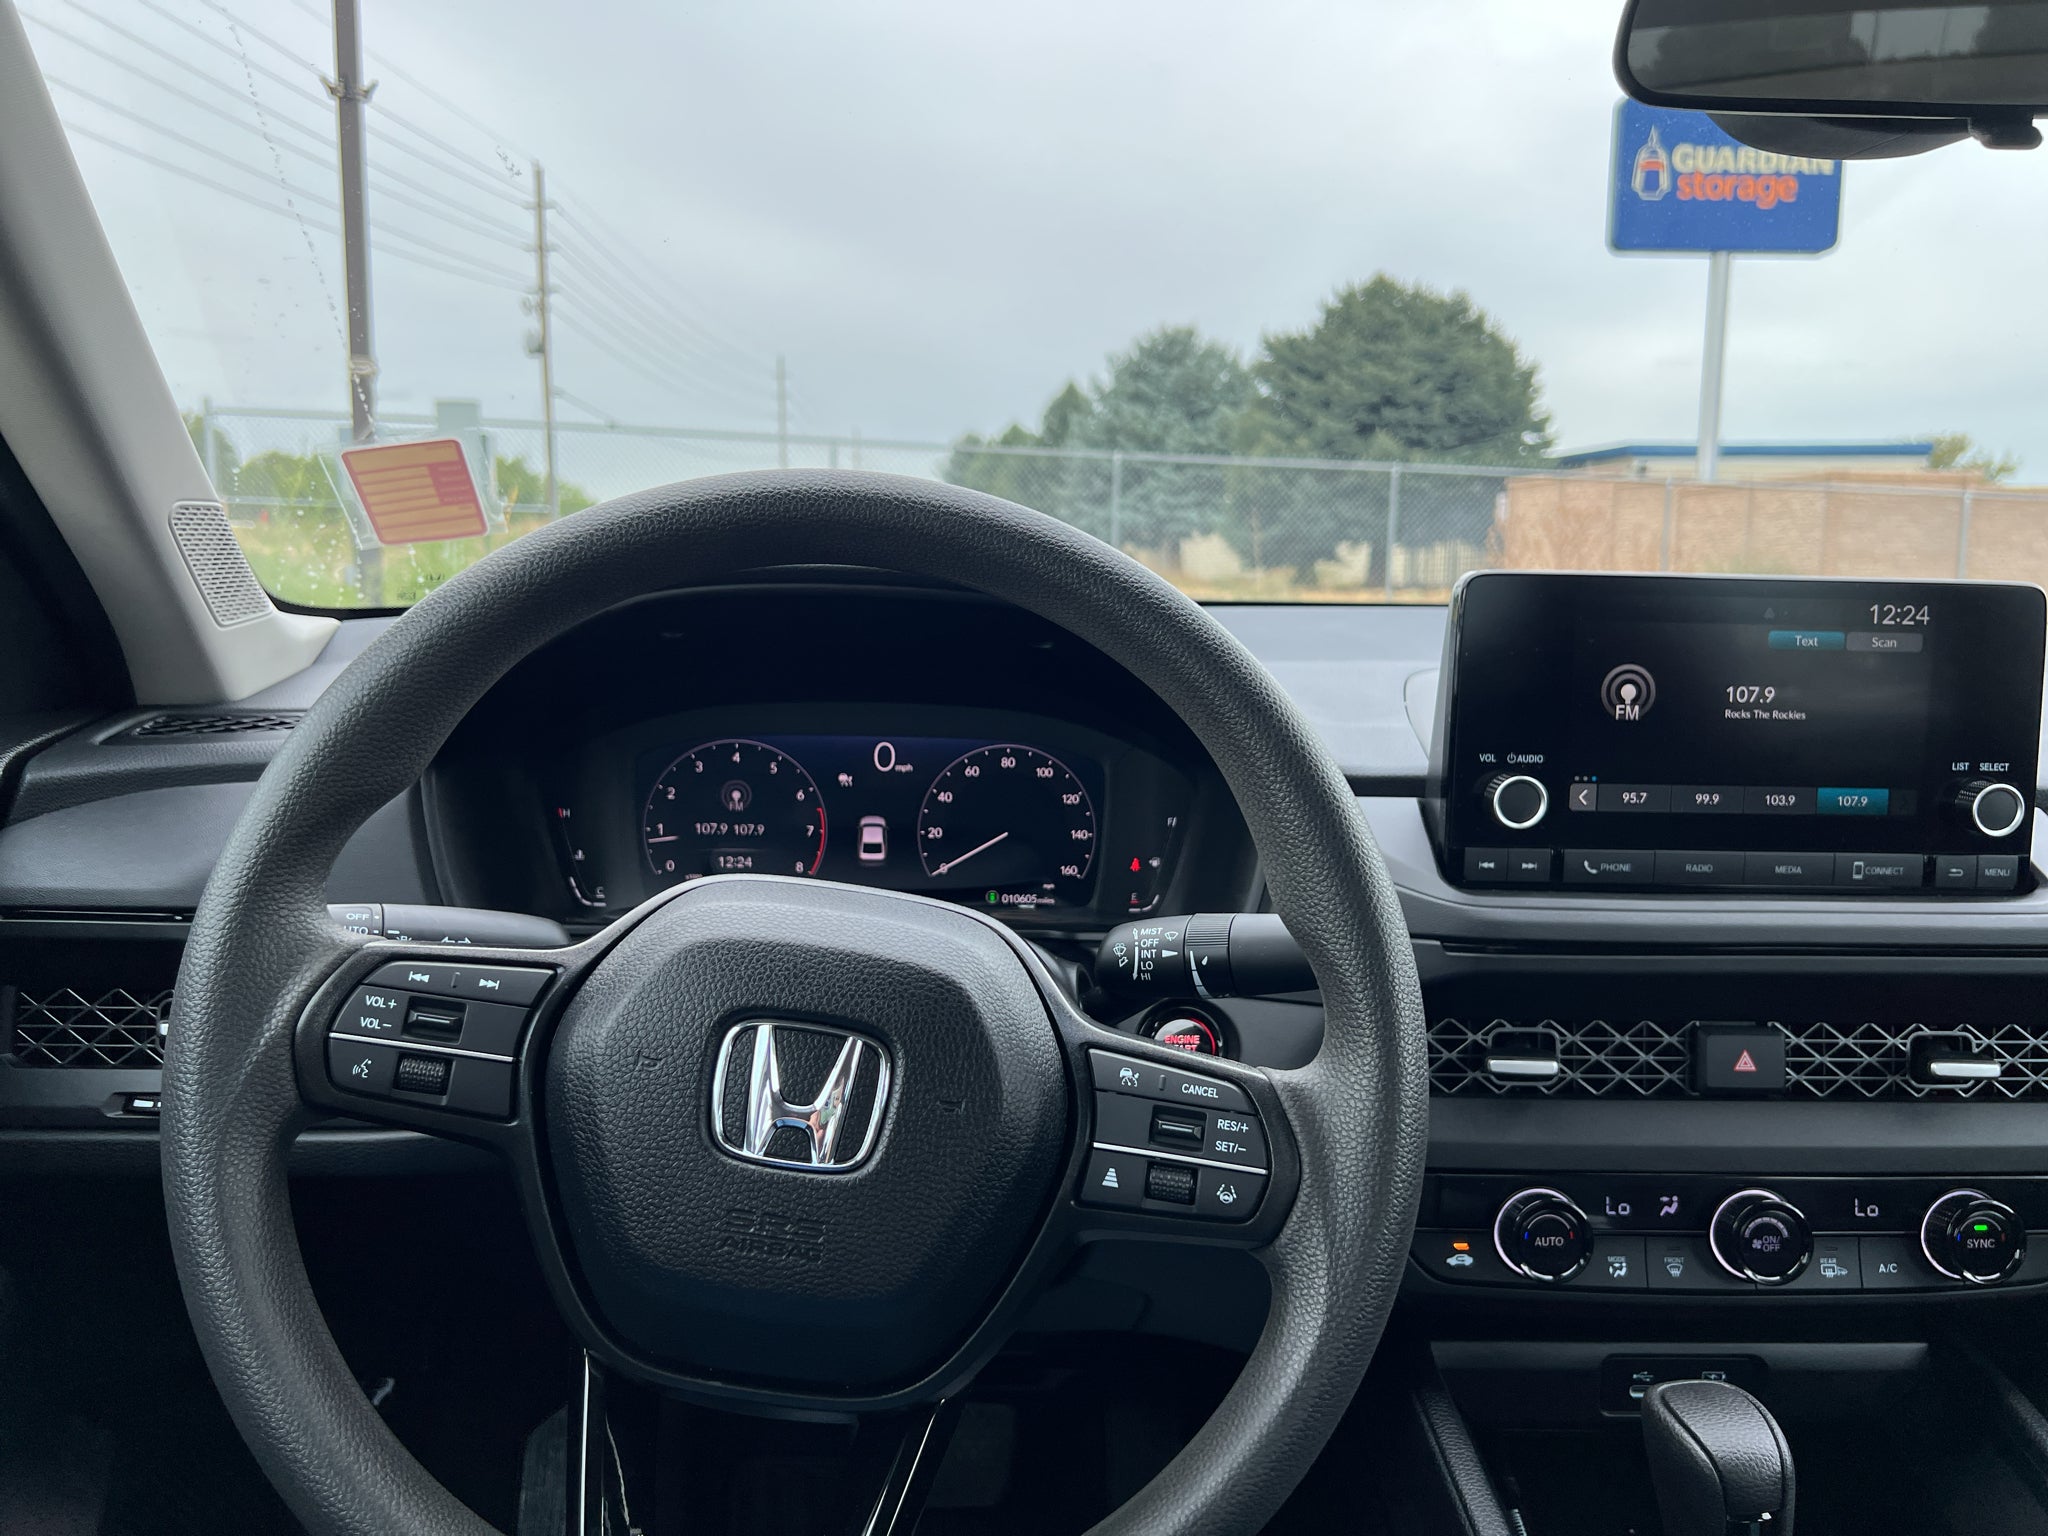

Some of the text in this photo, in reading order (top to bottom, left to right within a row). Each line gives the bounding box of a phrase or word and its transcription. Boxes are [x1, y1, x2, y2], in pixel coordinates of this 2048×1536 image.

[1677, 170, 1798, 209] storage
[1869, 604, 1930, 625] 12:24
[1793, 635, 1819, 647] Text
[1871, 637, 1897, 648] Scan
[1726, 686, 1776, 703] 107.9
[1615, 704, 1640, 720] FM
[1724, 709, 1806, 721] Rocks The Rockies
[732, 752, 741, 764] 4
[873, 741, 896, 772] 0
[1479, 754, 1544, 764] VOL AUDIO
[695, 761, 704, 773] 3
[770, 762, 778, 775] 5
[1000, 757, 1016, 769] 80
[1951, 762, 2010, 772] LIST SELECT
[964, 766, 980, 777] 60
[1035, 767, 1054, 778] 100
[665, 787, 676, 800] 2
[796, 790, 805, 801] 6
[936, 791, 953, 803] 40
[1062, 793, 1079, 804] 120
[1622, 792, 1648, 804] 95.7
[1695, 794, 1720, 805] 99.9
[1765, 795, 1796, 807] 103.9
[1836, 794, 1868, 806] 107.9
[729, 801, 744, 812] FM
[695, 823, 765, 836] 107.9 107.9
[806, 825, 815, 837] 7
[927, 827, 943, 839] 20
[1071, 830, 1087, 840] 140
[665, 860, 675, 872] 0
[718, 856, 753, 869] 12:24
[795, 862, 804, 874] 8
[1600, 863, 1632, 872] PHONE
[1061, 865, 1077, 876] 160
[1685, 864, 1714, 873] RADIO
[1774, 866, 1803, 874] MEDIA
[1864, 867, 1904, 875] CONNECT
[1984, 868, 2011, 877] MENU
[1001, 893, 1037, 903] 010605
[345, 913, 370, 921] OFF
[1140, 928, 1164, 936] MIST
[1140, 938, 1159, 947] OFF
[1140, 949, 1158, 959] INT
[1140, 961, 1154, 971] LO
[1140, 973, 1151, 981] HI
[1164, 1034, 1200, 1044] ENGINE
[1181, 1083, 1219, 1099] CANCEL
[1605, 1197, 1631, 1215] Lo
[1854, 1199, 1879, 1216] Lo
[1534, 1237, 1565, 1247] AUTO
[1762, 1236, 1780, 1244] ON/
[1966, 1239, 1996, 1249] SYNC
[1762, 1243, 1780, 1252] OFF
[1607, 1256, 1627, 1264] MODE
[1663, 1257, 1685, 1265] FRONT
[1878, 1264, 1898, 1274] A/C
